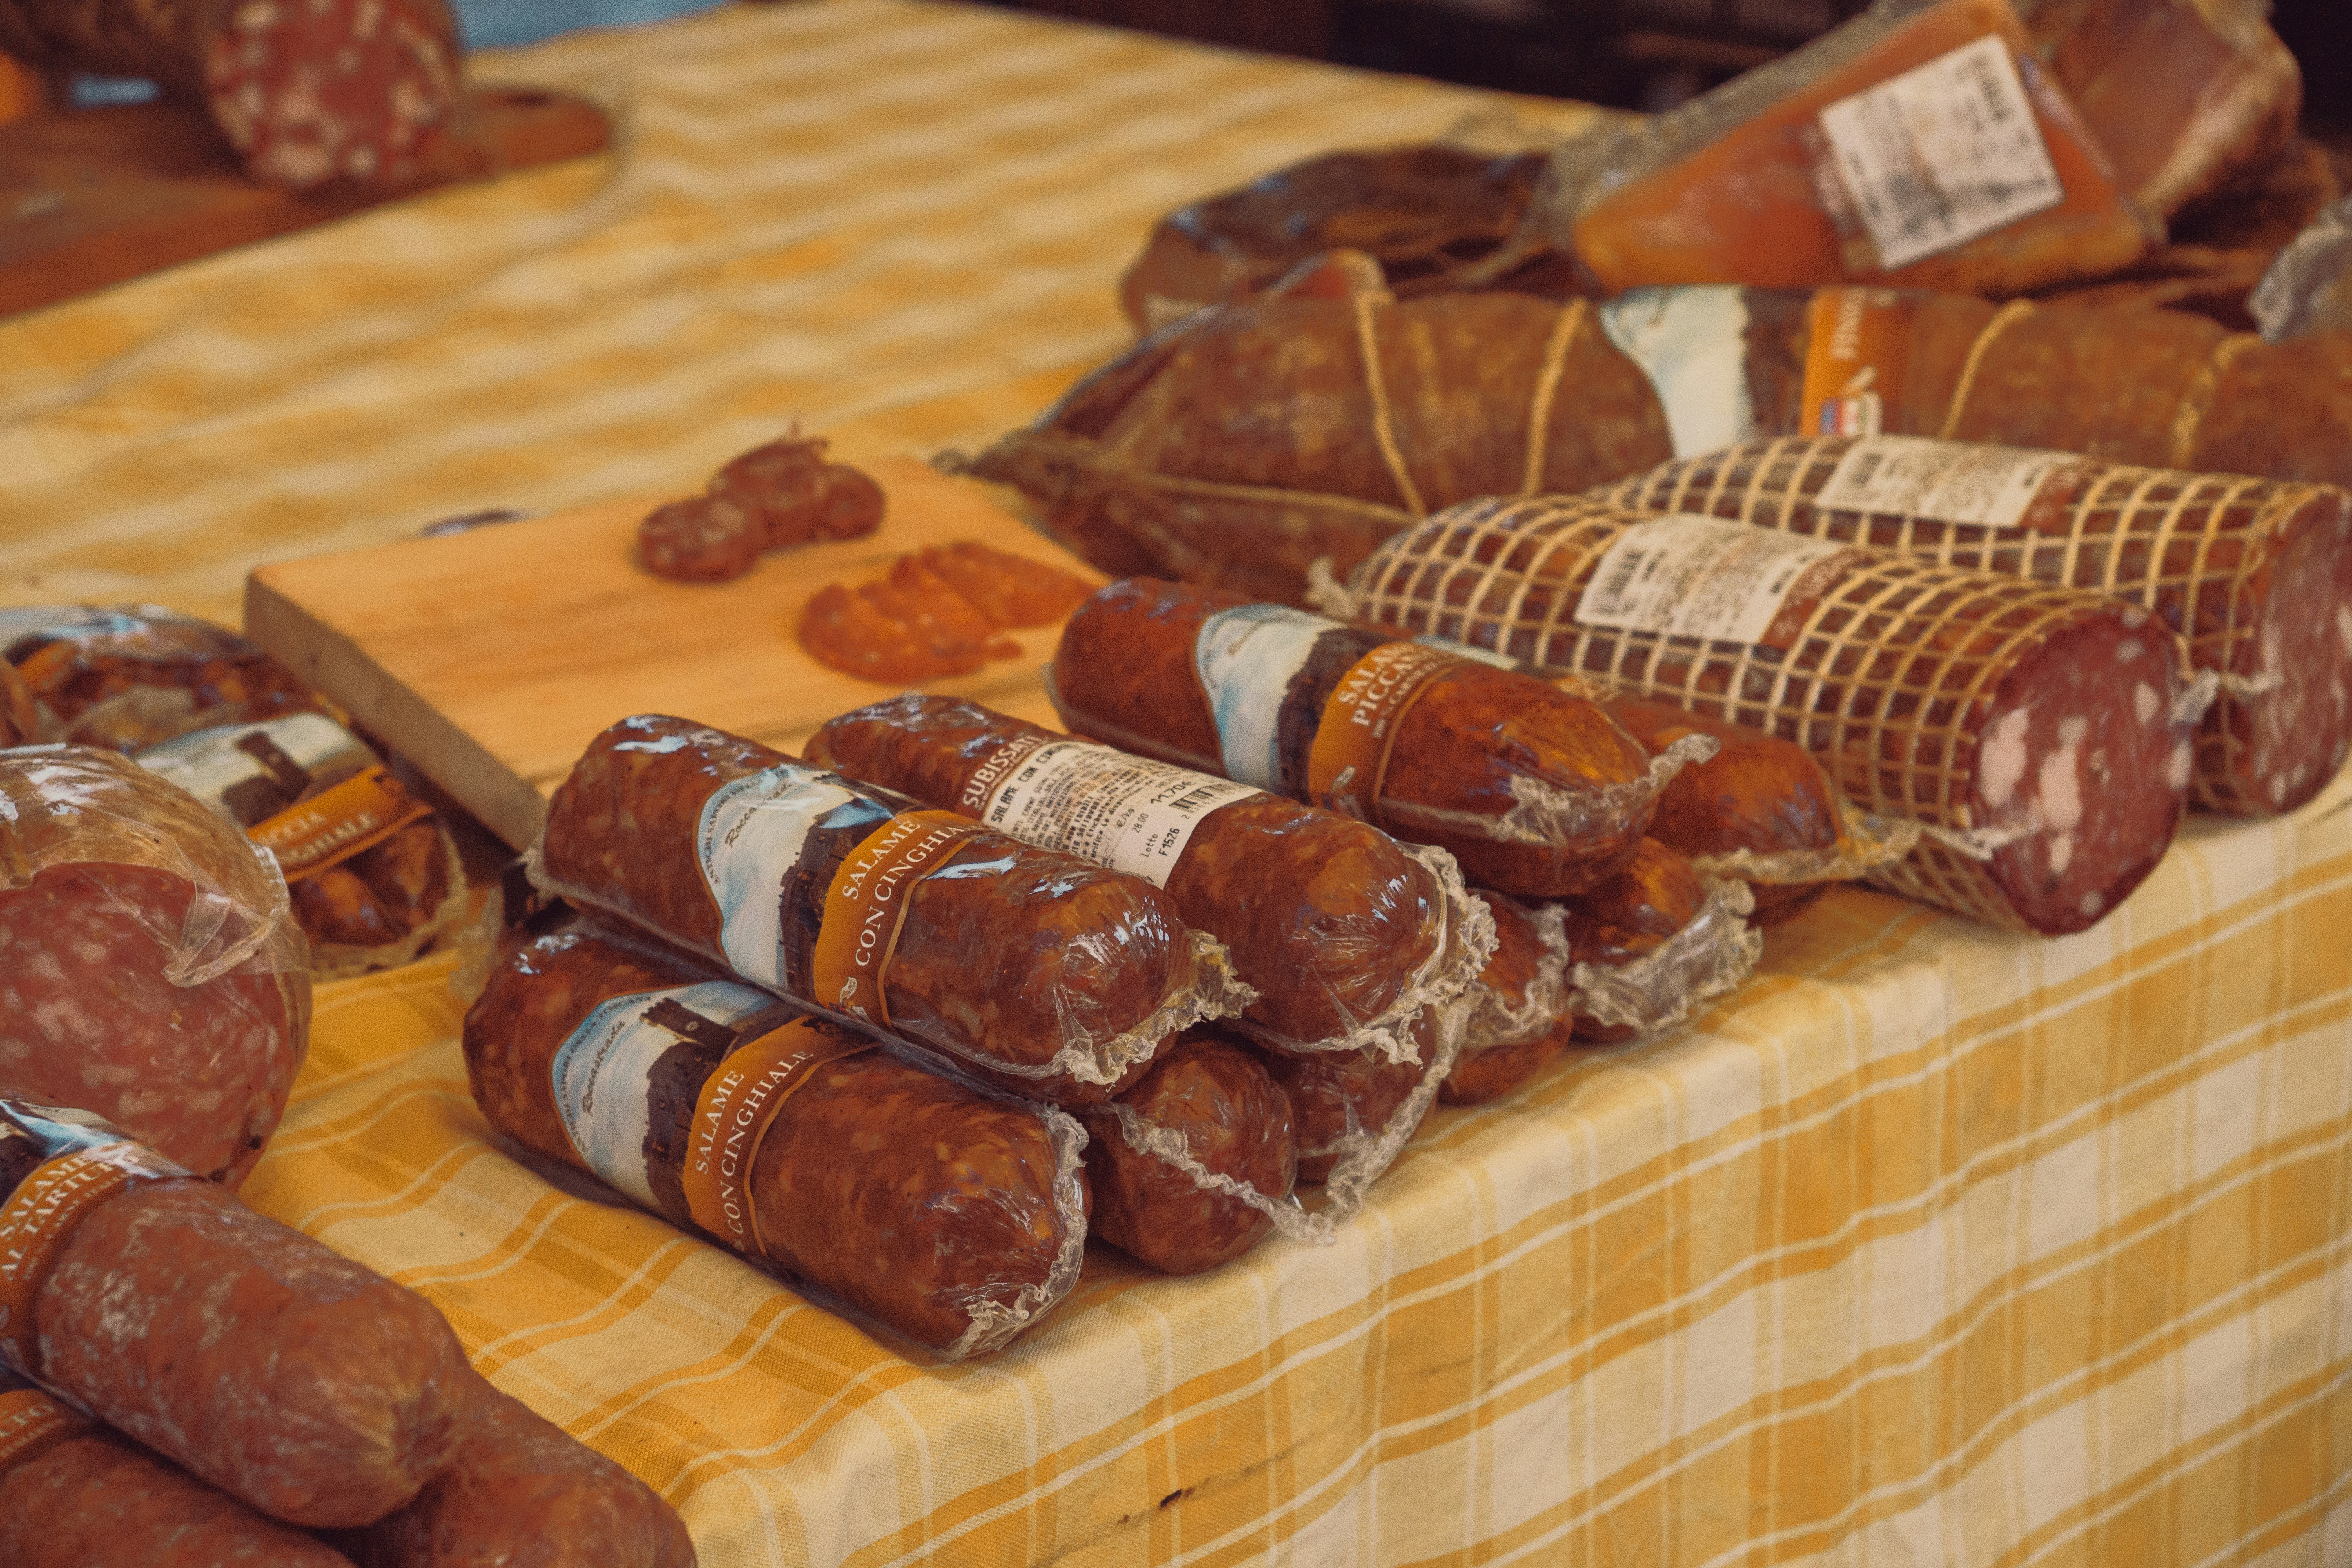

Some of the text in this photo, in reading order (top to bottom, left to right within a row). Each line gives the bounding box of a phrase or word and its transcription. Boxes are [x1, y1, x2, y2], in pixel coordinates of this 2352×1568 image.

[1350, 650, 1435, 726] PICCAN
[963, 735, 1041, 808] SUBISSATI
[991, 786, 1019, 823] SALAME
[1018, 767, 1038, 782] CON
[708, 794, 730, 832] SAPORI
[1065, 825, 1077, 841] NON
[1117, 808, 1135, 828] €/kg
[704, 837, 721, 884] ANTICHI
[842, 818, 921, 901] SALAME
[1091, 830, 1103, 858] erifica
[1141, 833, 1158, 857] Lotto
[855, 823, 972, 967] CON CINGHIA
[695, 1070, 745, 1174] SALAME
[721, 1051, 813, 1234] CON CINGHIALE
[0, 1155, 93, 1240] SALAME
[2, 1247, 28, 1281] AL
